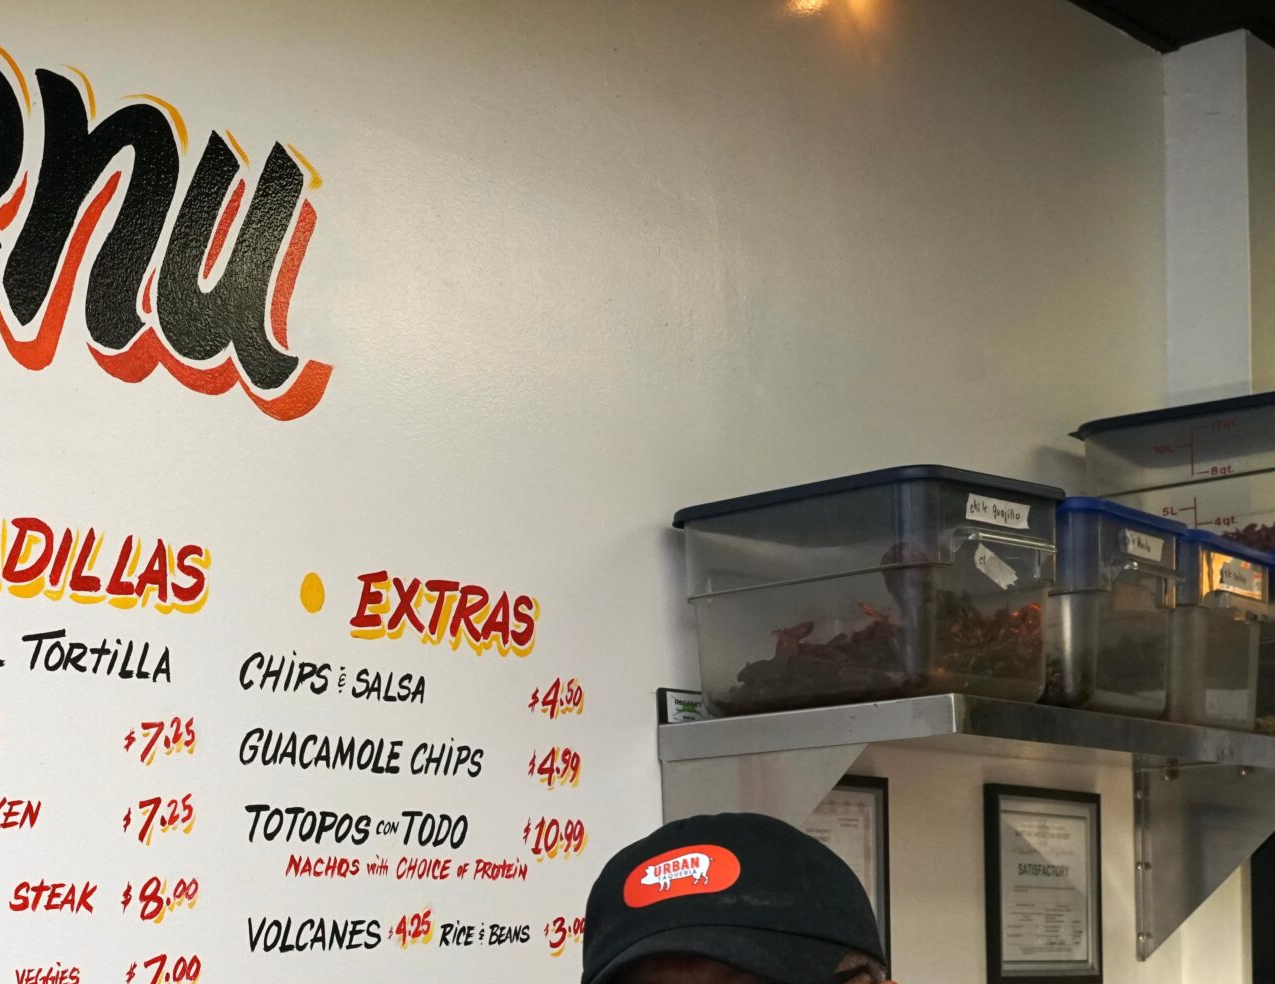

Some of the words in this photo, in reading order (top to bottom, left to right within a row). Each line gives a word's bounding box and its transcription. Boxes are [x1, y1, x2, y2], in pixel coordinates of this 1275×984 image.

[350, 571, 540, 657] EXTRAS
[352, 669, 425, 703] SALSA
[529, 678, 585, 722] $4.50
[125, 717, 198, 766] $7.25
[240, 728, 403, 774] GUACAMOLE
[529, 747, 583, 789] $4.99
[123, 794, 196, 846] $7.25
[245, 805, 371, 845] TOTOPOS
[402, 811, 468, 849] TODO
[524, 818, 588, 858] $10.99
[286, 855, 359, 877] NACHOS
[397, 857, 451, 879] CHOICE
[653, 856, 701, 877] URBAN
[658, 870, 697, 882] TAQUERIA
[1018, 863, 1070, 878] SATISFACTORY
[122, 877, 201, 924] $8.00
[248, 917, 381, 953] VOLCANES
[388, 909, 434, 947] $4.25
[489, 924, 530, 945] BEANS
